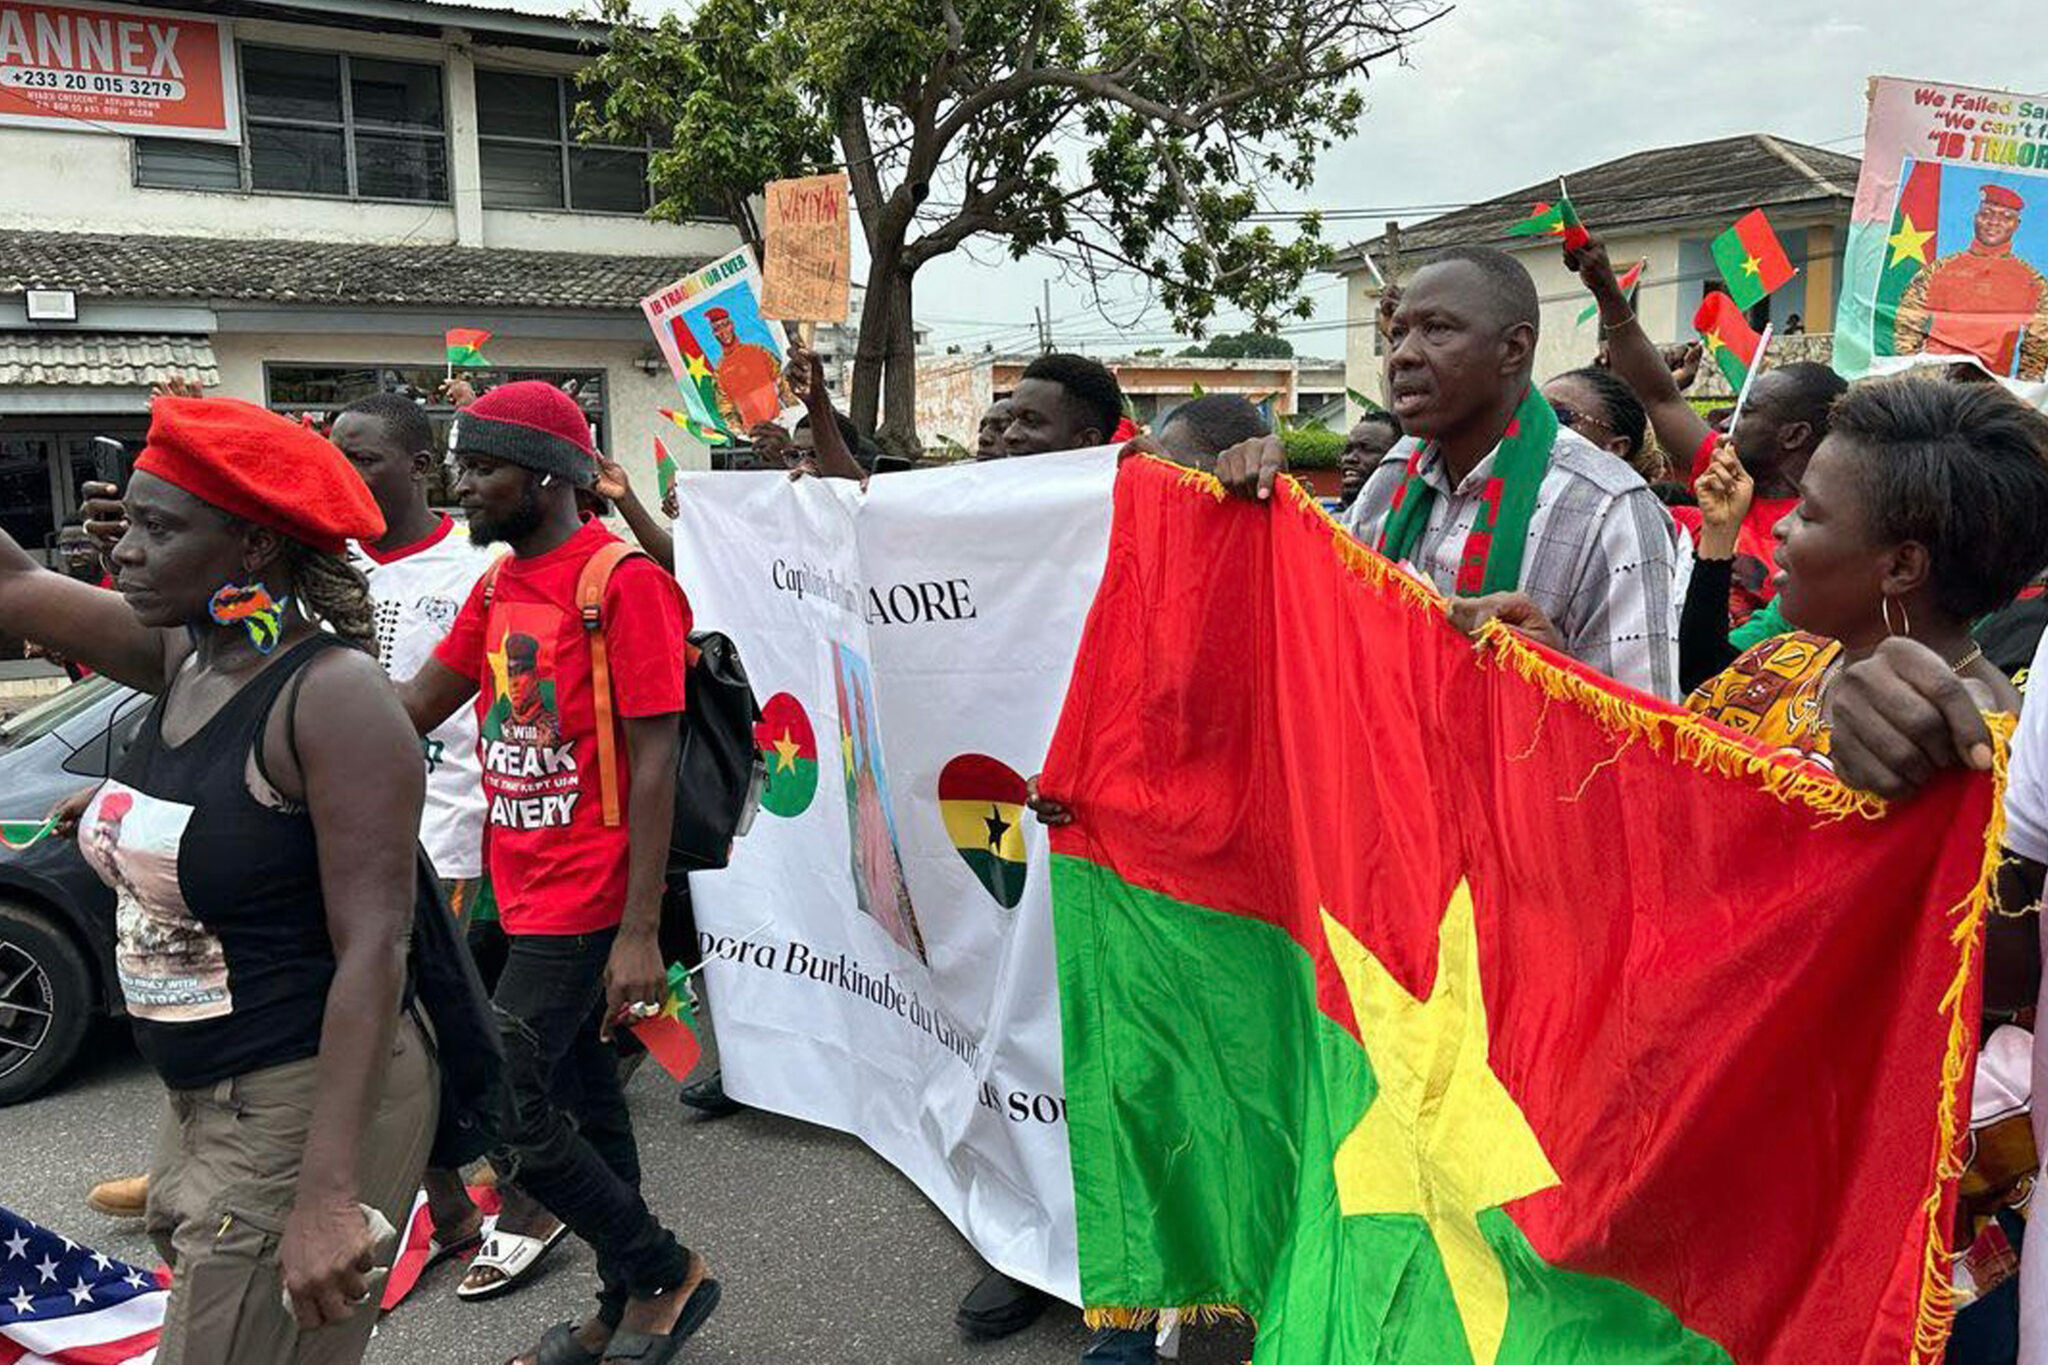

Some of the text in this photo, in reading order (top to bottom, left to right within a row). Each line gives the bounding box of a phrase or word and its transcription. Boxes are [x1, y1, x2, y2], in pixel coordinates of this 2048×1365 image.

[0, 9, 184, 79] ANNEX
[13, 70, 172, 97] +233 20 015 3279
[1914, 88, 2048, 119] We Failed Sa
[649, 300, 664, 316] IB
[720, 254, 748, 279] EVER
[865, 579, 977, 625] AORE
[490, 792, 579, 828] AVERY
[783, 942, 907, 1017] Burkinabe
[909, 991, 932, 1035] du
